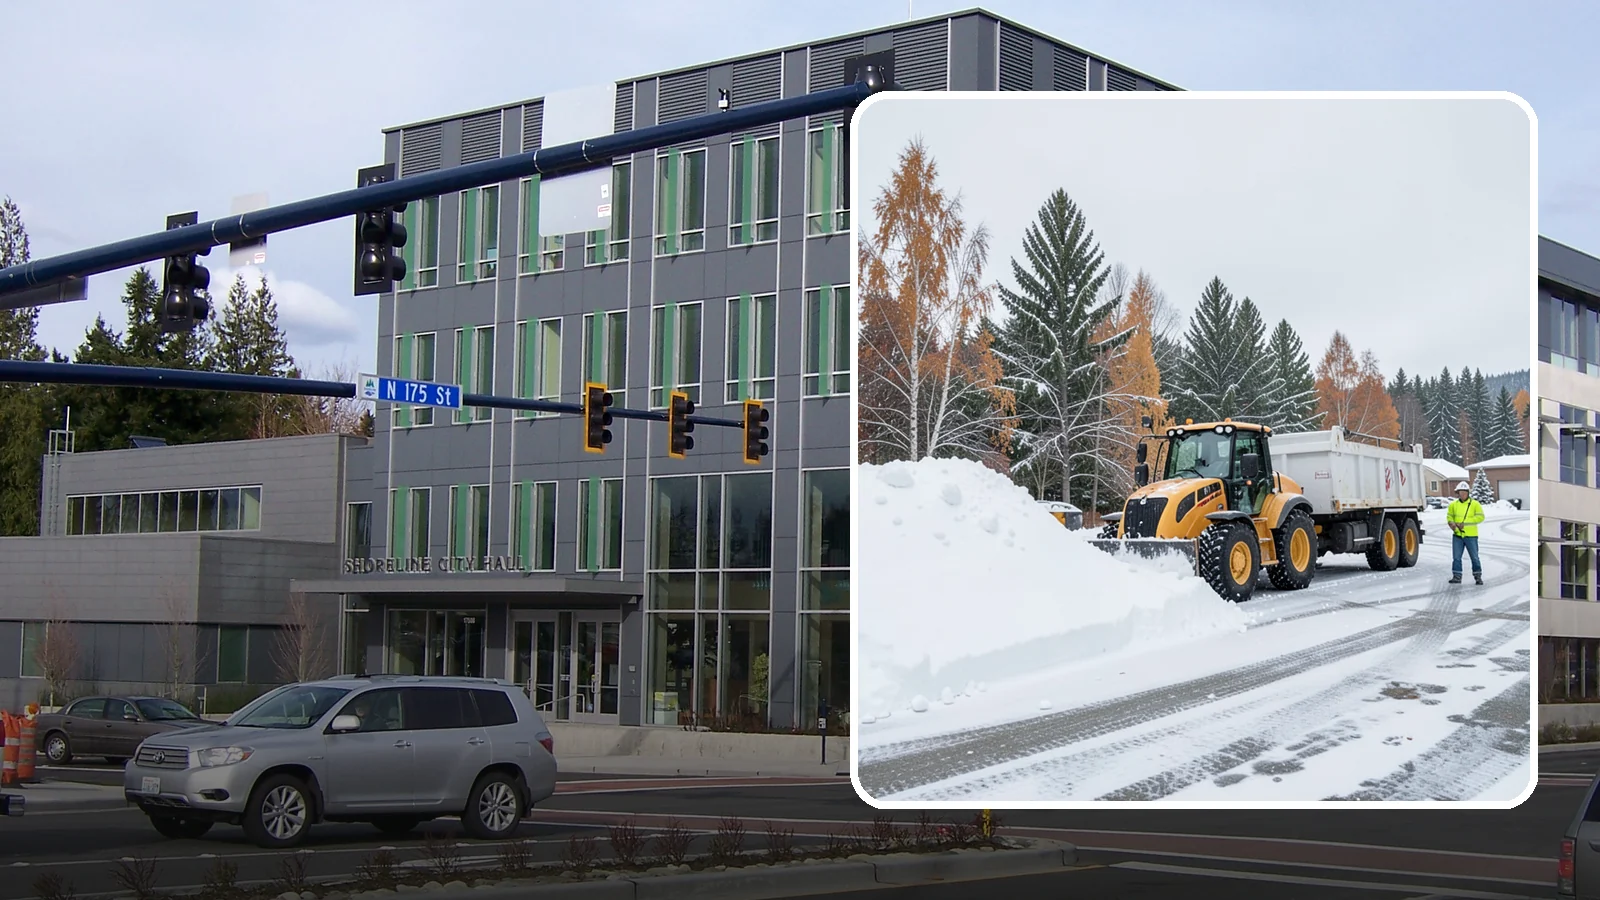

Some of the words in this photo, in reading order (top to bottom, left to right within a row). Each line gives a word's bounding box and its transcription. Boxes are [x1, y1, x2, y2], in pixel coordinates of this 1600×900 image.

[387, 380, 396, 400] N
[405, 382, 427, 403] 175
[436, 386, 451, 405] St
[344, 557, 431, 574] SHORELINE
[438, 557, 475, 572] CITY
[483, 555, 525, 571] HALL
